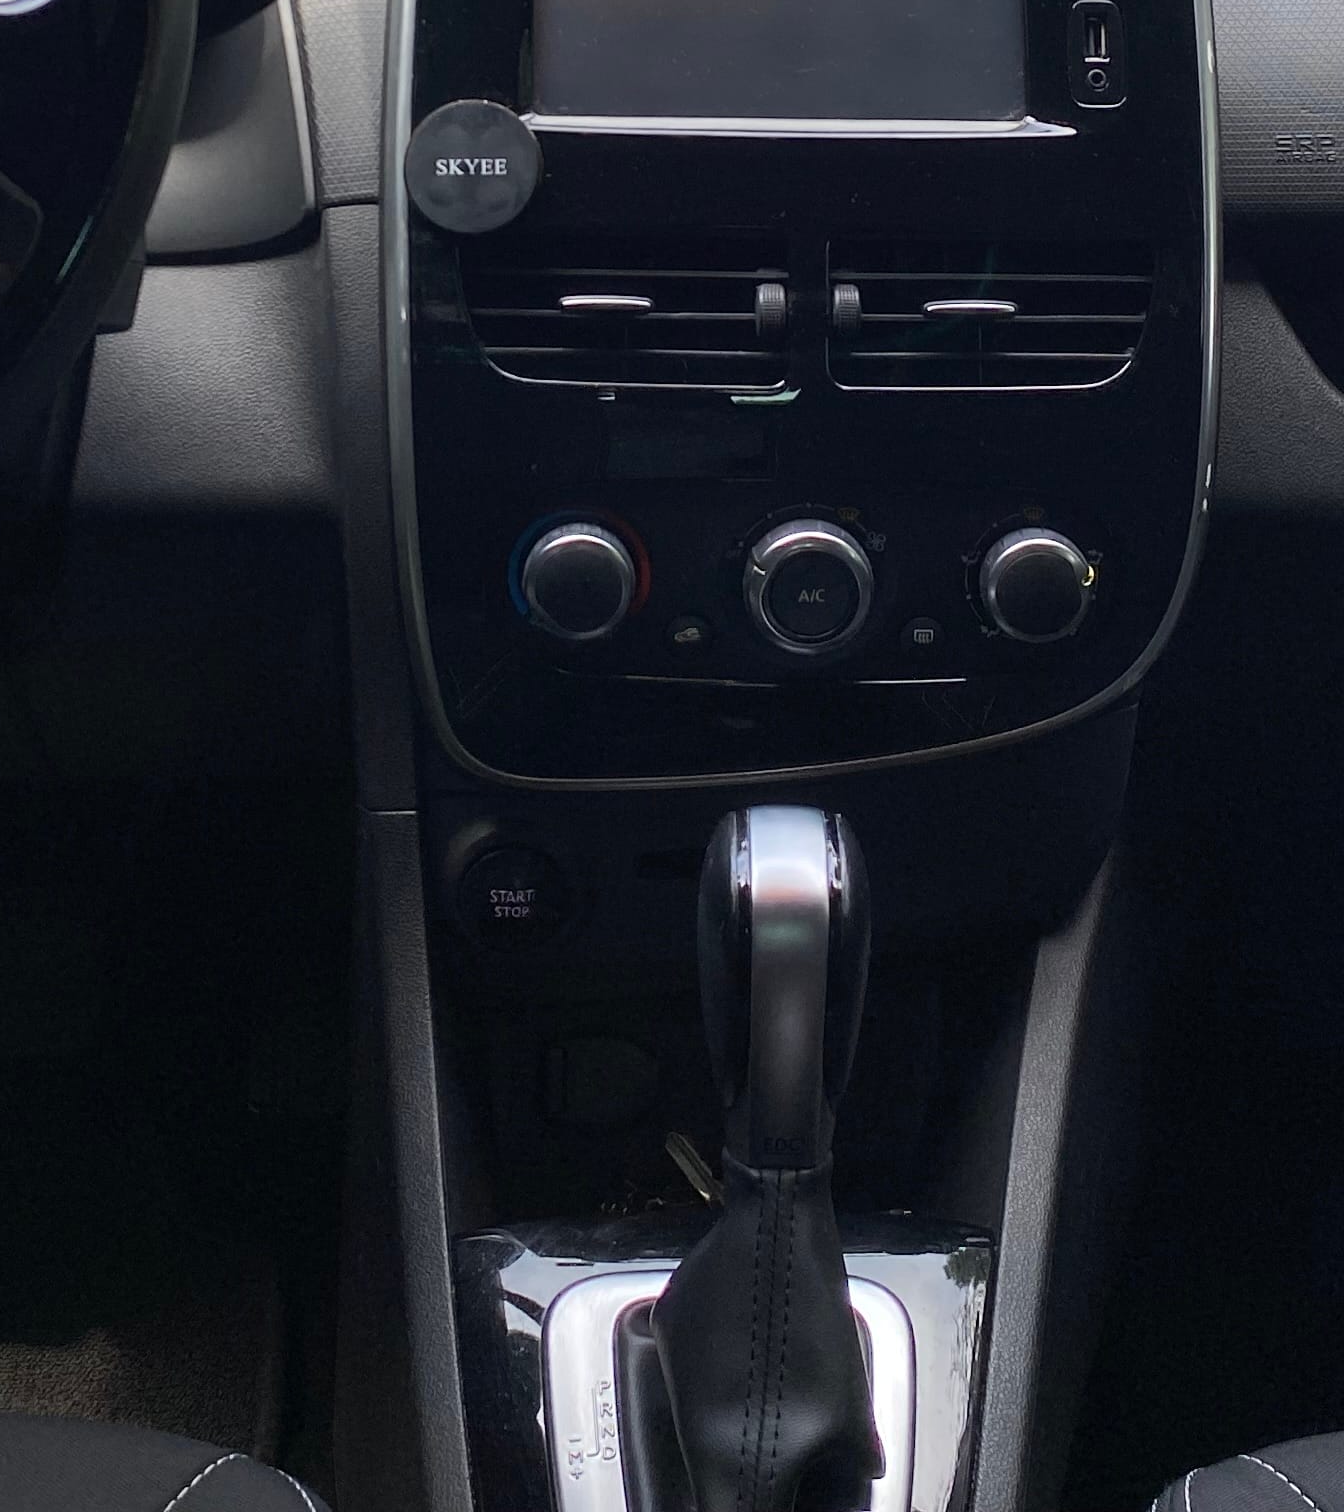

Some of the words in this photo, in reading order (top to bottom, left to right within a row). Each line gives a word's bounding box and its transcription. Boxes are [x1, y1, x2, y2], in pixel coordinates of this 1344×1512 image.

[435, 158, 508, 176] SKYEE
[798, 589, 826, 603] A/C
[490, 889, 535, 904] START
[495, 906, 530, 918] STOP
